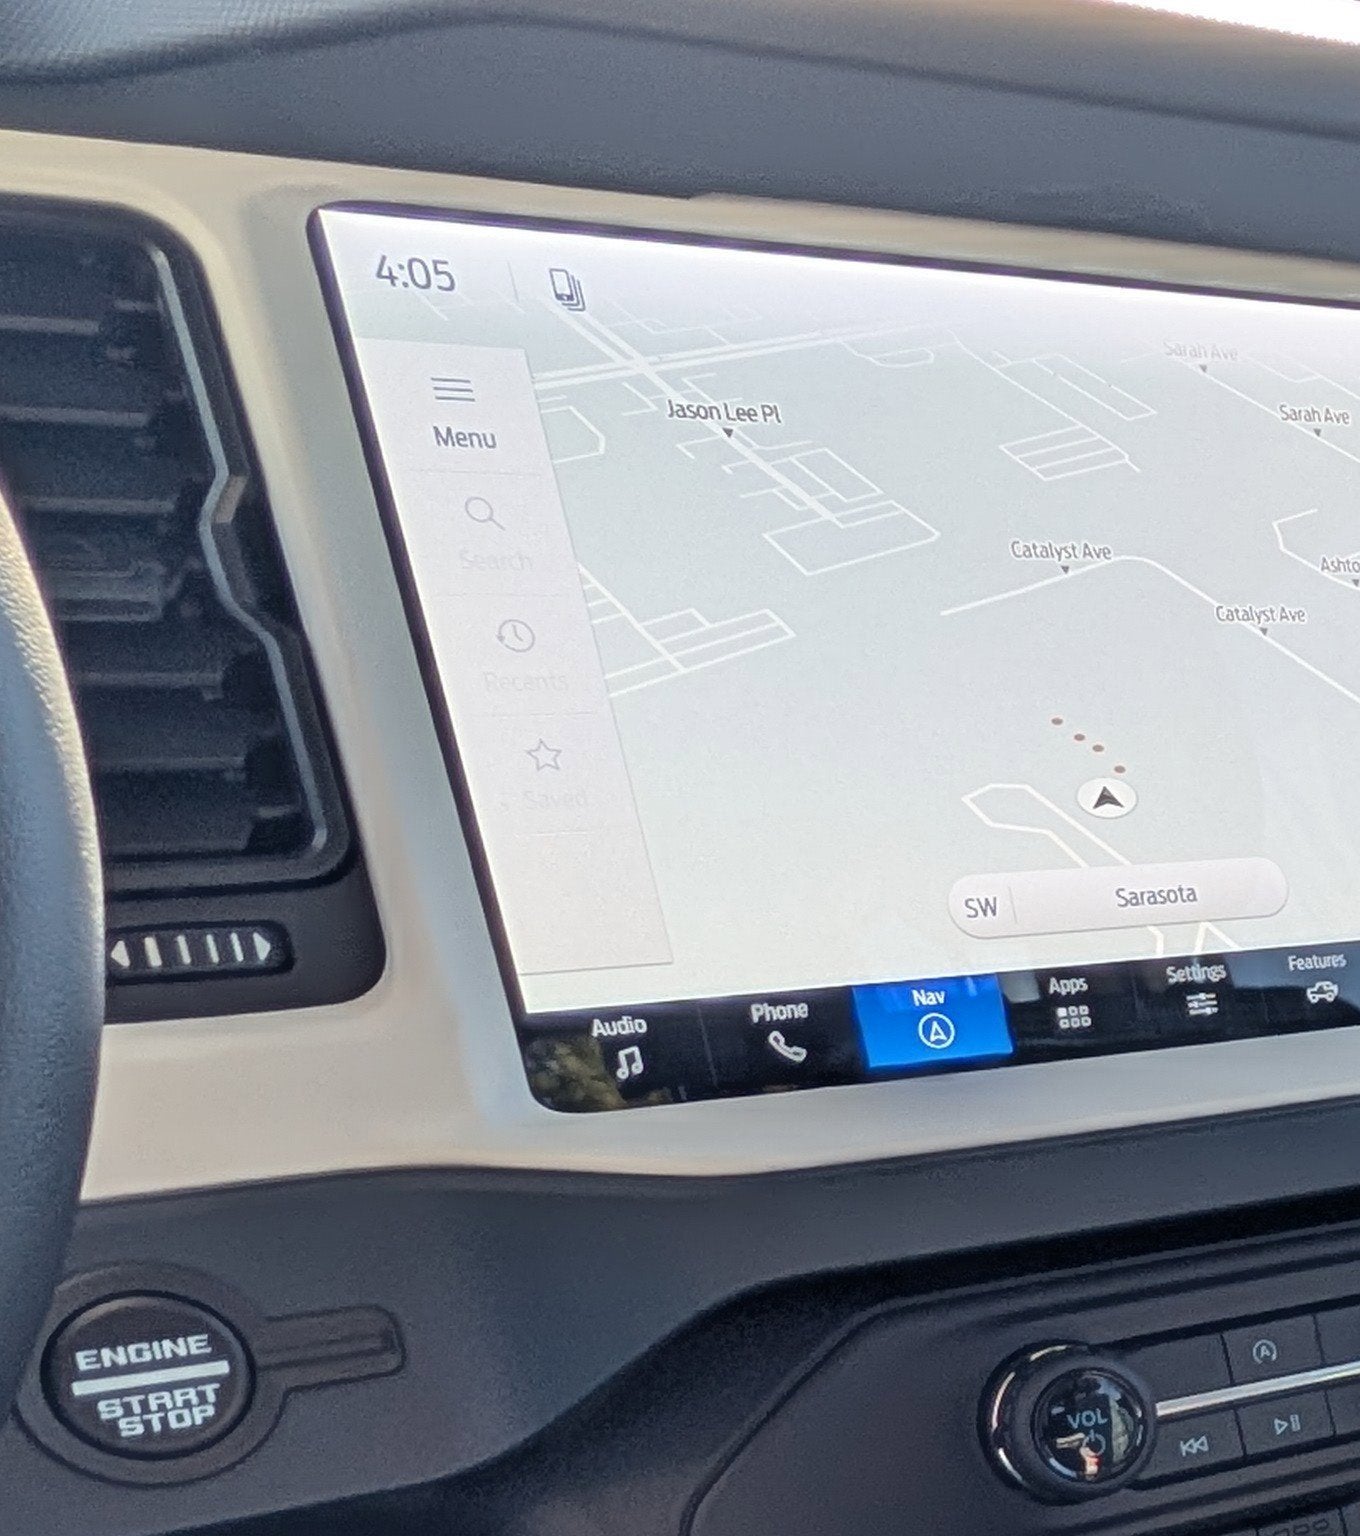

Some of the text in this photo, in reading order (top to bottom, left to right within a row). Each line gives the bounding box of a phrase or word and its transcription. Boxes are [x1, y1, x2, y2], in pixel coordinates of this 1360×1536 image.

[375, 255, 457, 292] 4:05
[667, 399, 782, 424] Jason Lee Pl
[1279, 404, 1350, 424] Sarah Ave
[433, 426, 497, 450] Menu
[1011, 541, 1111, 563] Catalyst Ave
[1216, 606, 1305, 624] Catalyst Ave
[483, 671, 568, 692] Recents
[964, 884, 1198, 918] SW Sarasota
[1166, 961, 1227, 984] Settings
[1288, 953, 1346, 973] Features
[913, 988, 946, 1006] Nav
[1049, 974, 1089, 998] Apps
[751, 1001, 809, 1023] Phone
[592, 1017, 647, 1037] Audio
[75, 1334, 212, 1372] ENGINE
[96, 1383, 221, 1421] START
[118, 1405, 216, 1438] STOP
[1066, 1408, 1109, 1429] VOL
